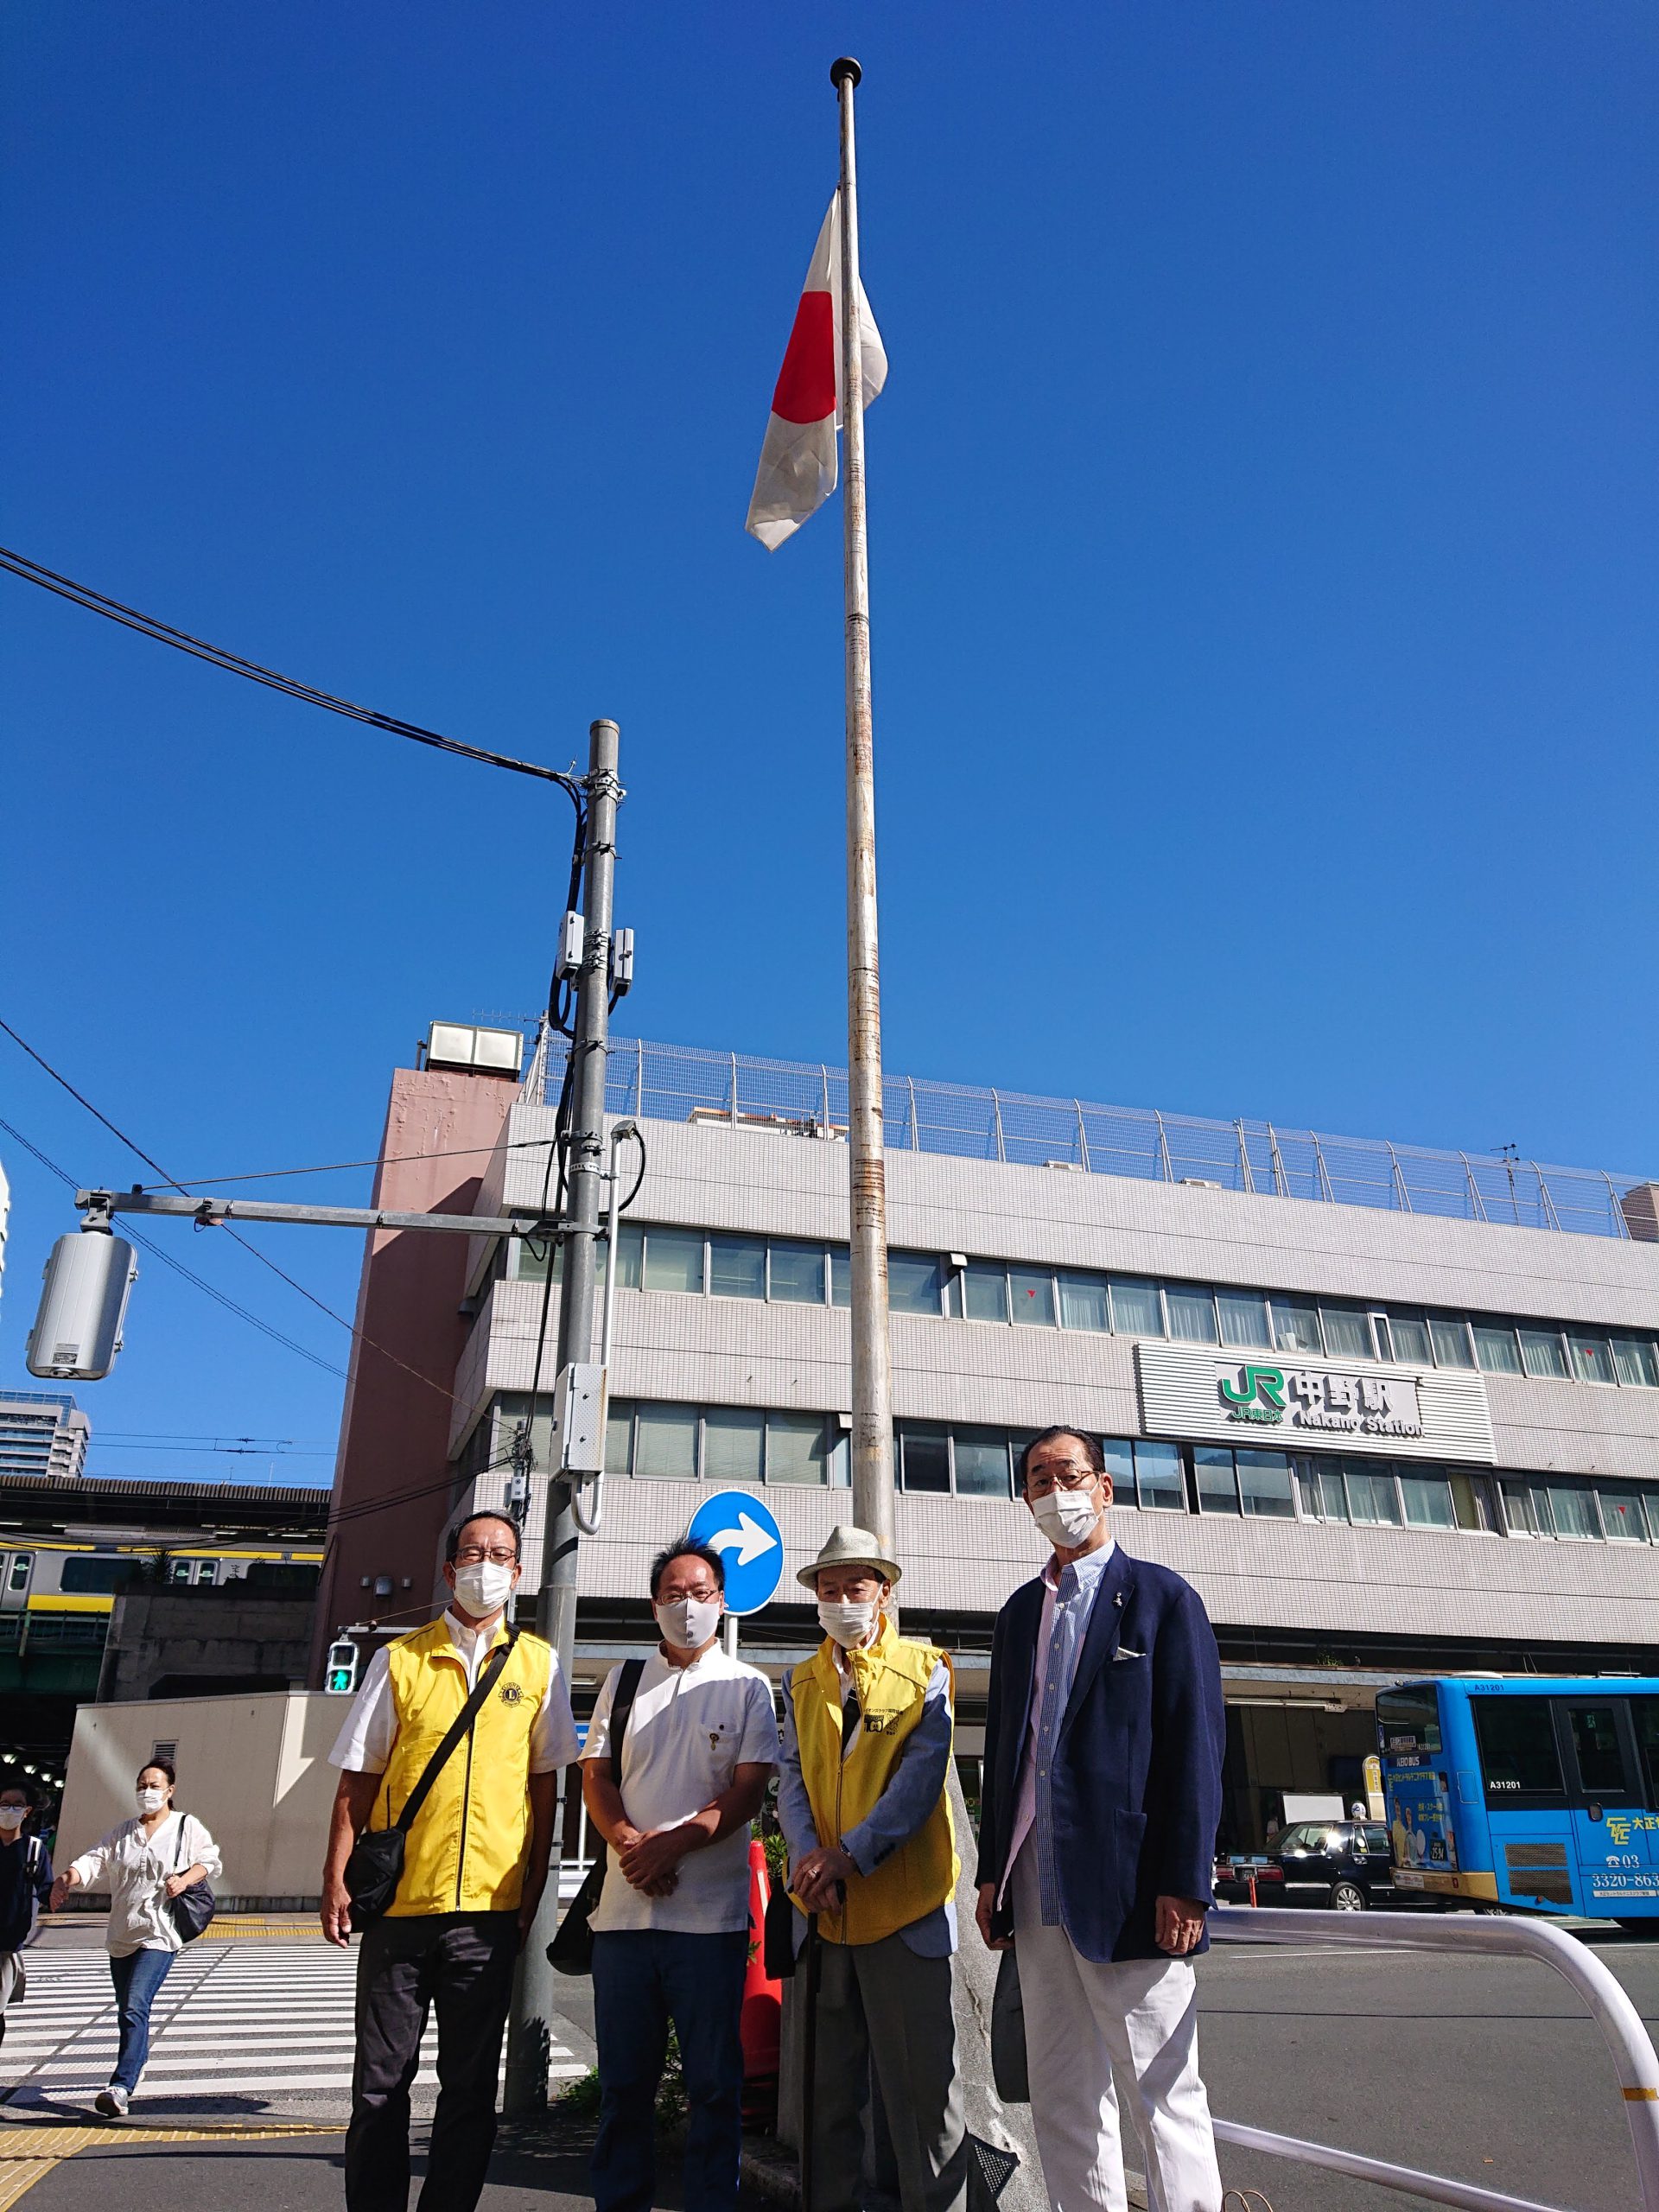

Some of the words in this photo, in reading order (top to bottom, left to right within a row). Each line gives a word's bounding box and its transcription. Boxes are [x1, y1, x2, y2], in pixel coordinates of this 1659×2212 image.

[1222, 1365, 1287, 1407] JR
[1295, 1370, 1394, 1412] 中野駅
[1233, 1406, 1284, 1423] JR東日本
[1300, 1409, 1360, 1430] Nakano
[1366, 1415, 1425, 1436] Station
[1408, 1756, 1420, 1766] BUS
[1490, 1781, 1521, 1789] A31201
[1622, 1854, 1640, 1869] 03
